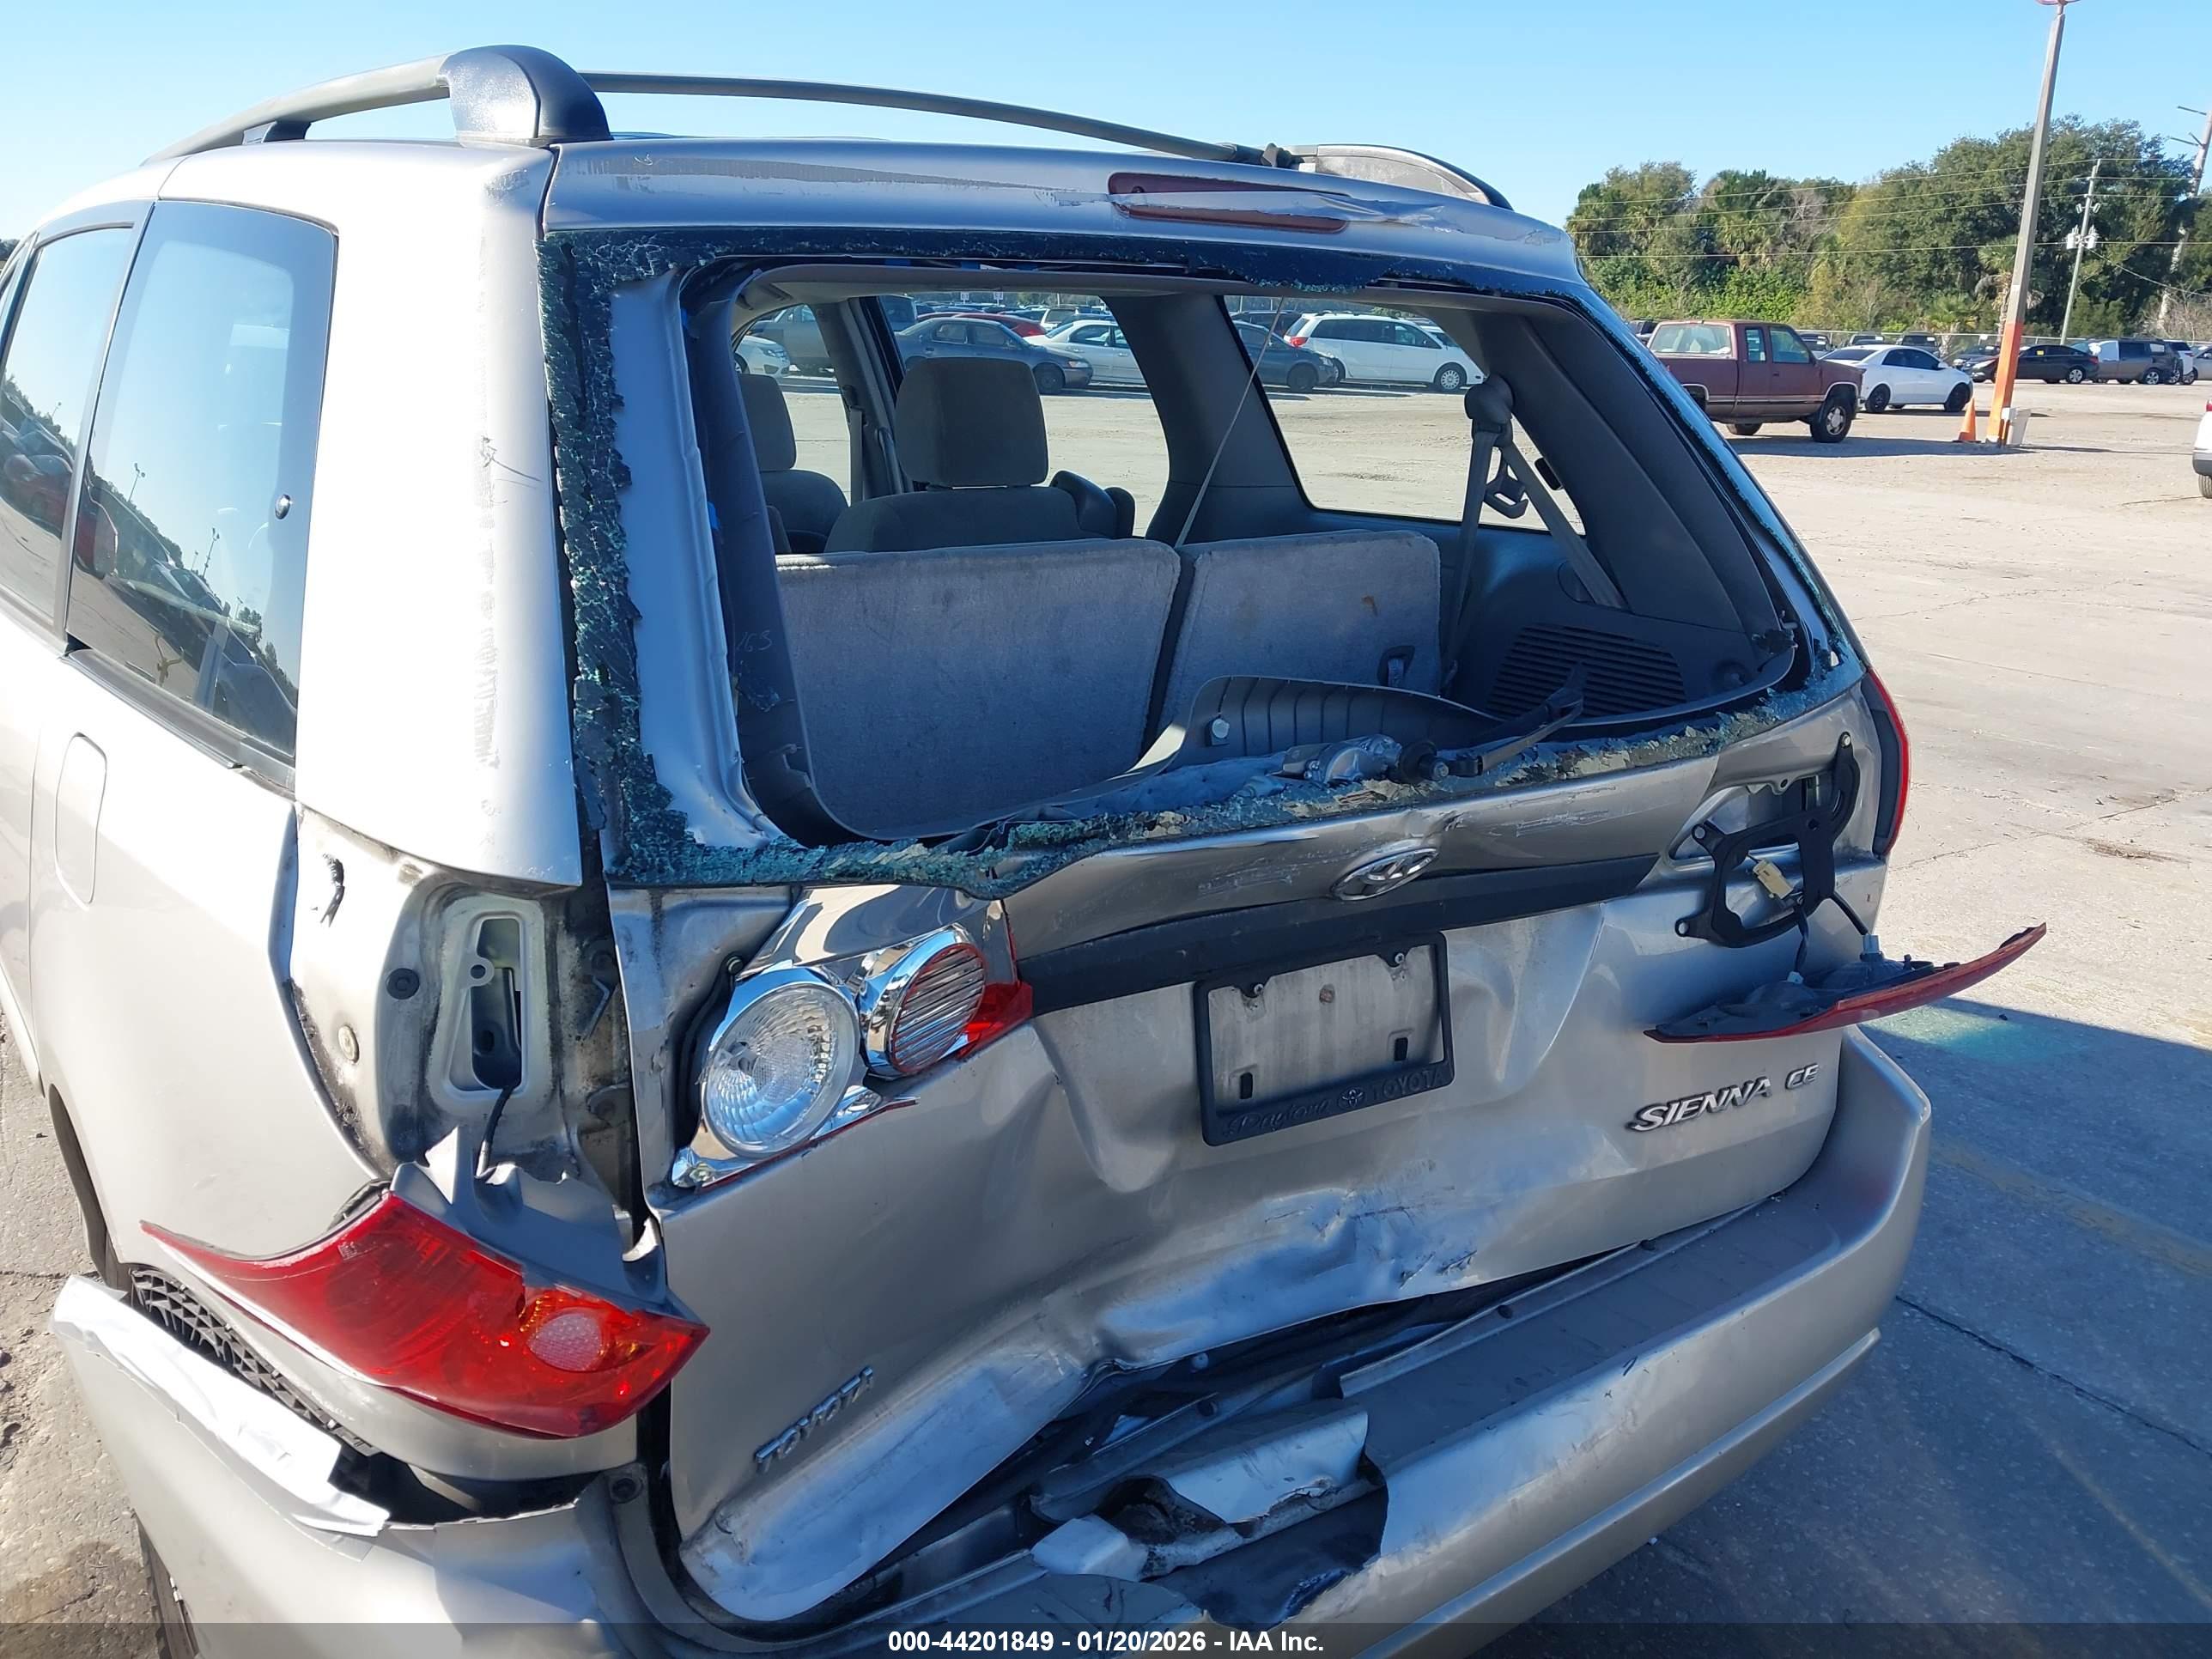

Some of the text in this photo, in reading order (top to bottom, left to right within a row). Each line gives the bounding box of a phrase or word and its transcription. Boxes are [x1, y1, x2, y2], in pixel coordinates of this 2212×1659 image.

[1370, 1068, 1445, 1101] TOYOTA
[1626, 1062, 1820, 1133] SIENNA CE
